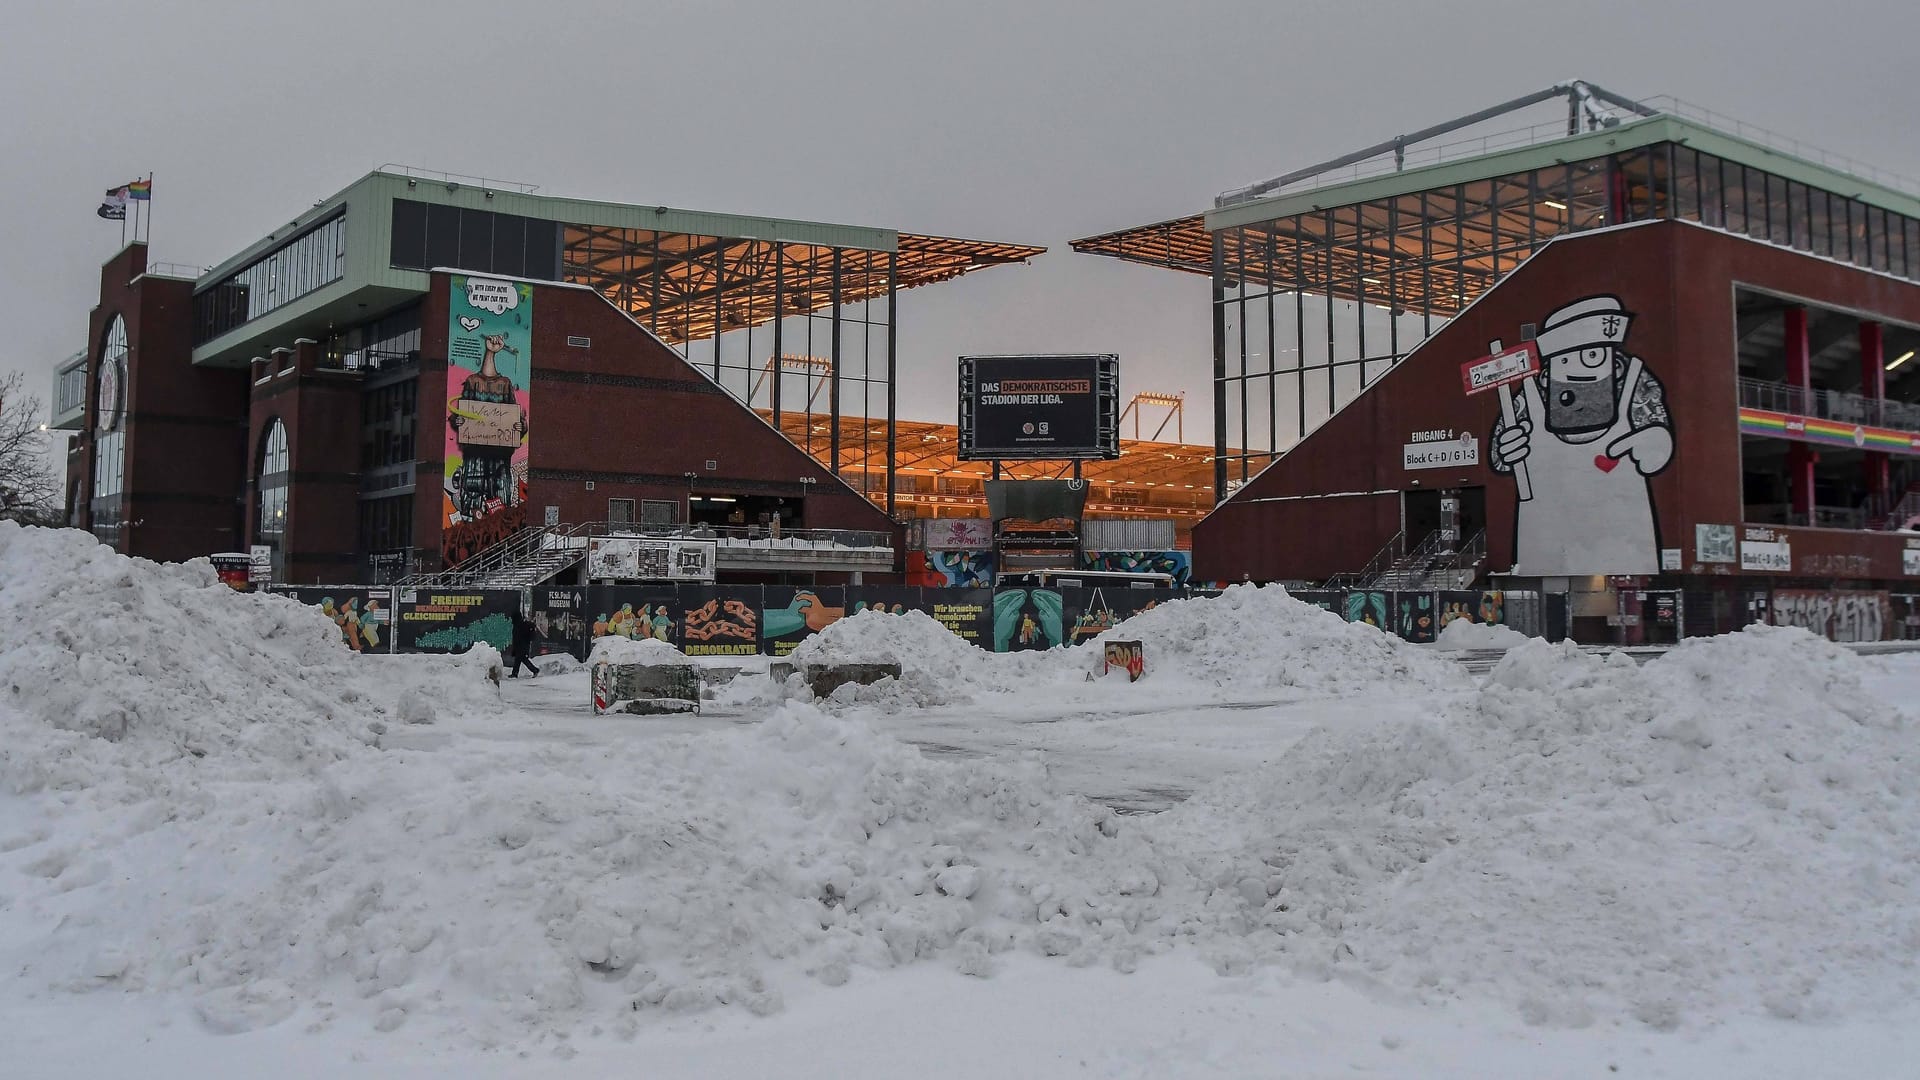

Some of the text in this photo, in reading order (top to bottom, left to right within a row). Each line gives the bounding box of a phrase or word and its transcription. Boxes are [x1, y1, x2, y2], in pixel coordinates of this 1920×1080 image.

[1520, 358, 1526, 369] 1
[1474, 373, 1482, 384] 2
[981, 381, 1088, 393] DAS DEMOKRATISCHSTE
[981, 394, 1064, 405] STADION DER LIGA.
[1411, 428, 1453, 442] EINGANG 4
[1406, 453, 1426, 464] Block
[1428, 453, 1433, 462] C
[1441, 451, 1447, 461] D
[1454, 451, 1460, 460] G
[1463, 449, 1475, 460] 1-3
[430, 595, 484, 606] FREIHEIT
[548, 599, 571, 608] MUSEUM
[415, 605, 469, 613] DEMOKRATIE
[933, 604, 983, 613] Wir brauchen
[403, 612, 456, 621] GLEICHHEIT
[933, 612, 976, 621] Demokratie
[949, 621, 960, 629] sie
[685, 645, 757, 655] DEMOKRATIE
